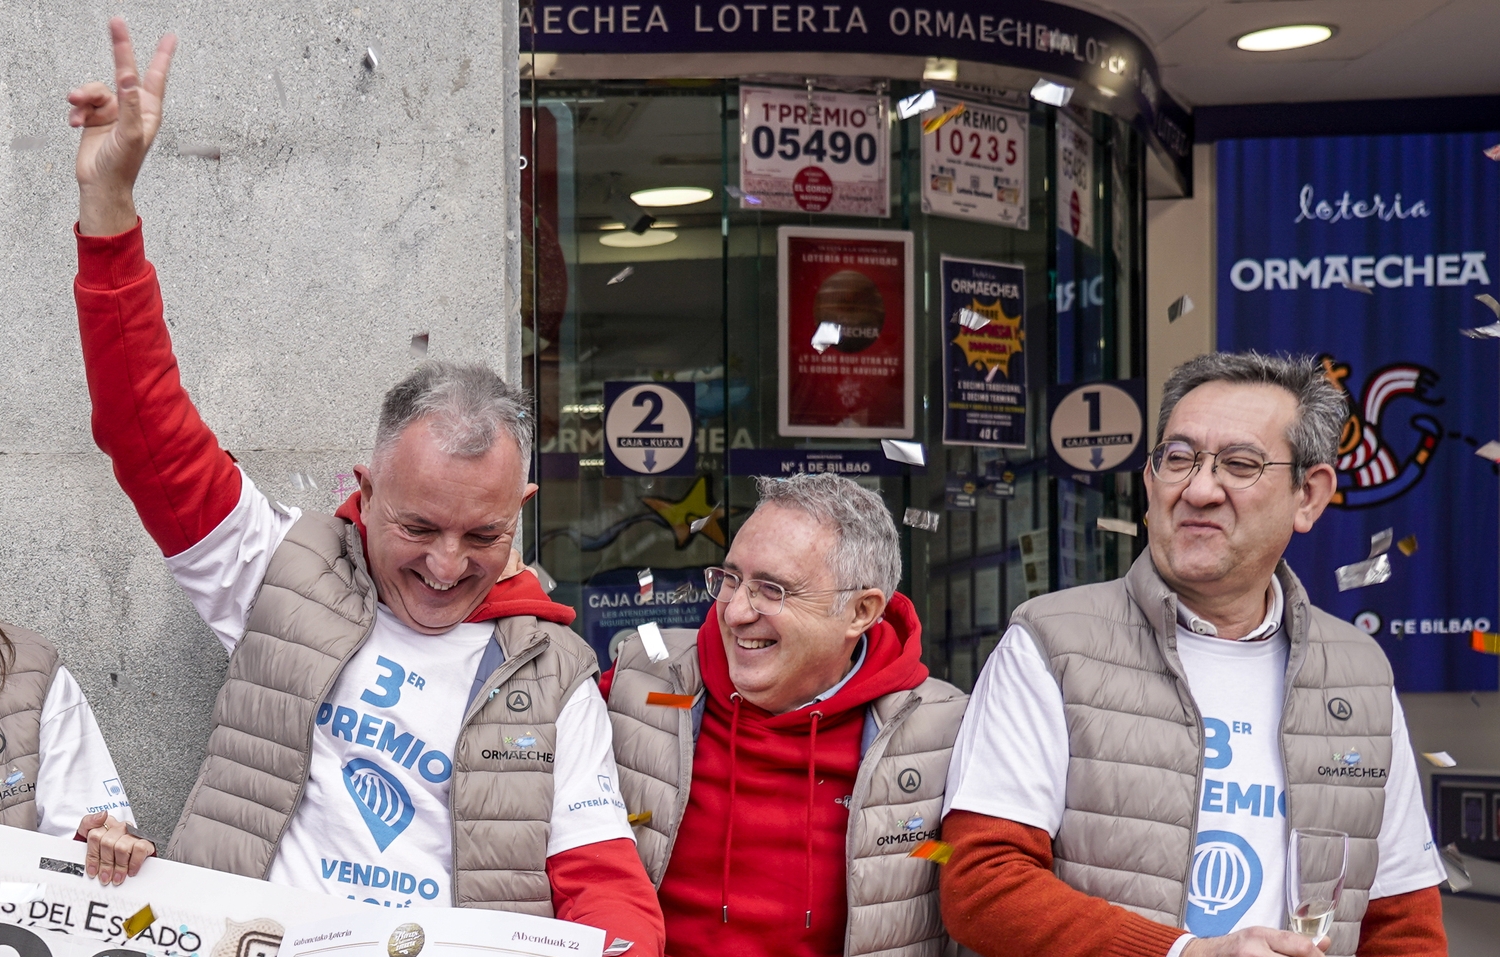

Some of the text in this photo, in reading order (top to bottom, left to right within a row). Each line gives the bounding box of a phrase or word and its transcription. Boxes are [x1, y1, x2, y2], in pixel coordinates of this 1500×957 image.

[519, 6, 669, 34] AECHEA
[694, 5, 867, 33] LOTERIA
[779, 104, 866, 128] PREMIO
[954, 111, 1008, 134] PREMIO
[752, 126, 876, 166] 05490
[935, 128, 1017, 166] 10235
[1230, 251, 1491, 292] ORMAECHEA
[951, 279, 1020, 299] ORMAECHEA
[842, 327, 879, 338] AECHEA
[632, 390, 664, 433] 2
[1083, 392, 1100, 432] 1
[621, 438, 681, 447] CAJA KUTXA
[1065, 436, 1130, 447] CAJA KUTXA
[808, 462, 823, 472] DE
[827, 463, 871, 473] BILBAO
[589, 593, 630, 608] CAJA
[619, 608, 666, 618] ATENDEMOS
[669, 607, 679, 616] EN
[681, 606, 697, 615] LAS
[1420, 617, 1491, 634] BILBAO
[316, 703, 453, 784] PREMIO
[1317, 766, 1387, 779] ORMAECHEA
[86, 802, 118, 813] LOTERÍA
[568, 797, 608, 812] LOTERÍA
[321, 858, 439, 900] VENDIDO
[85, 901, 202, 953] ESADO
[511, 930, 579, 951] Abenduak 22
